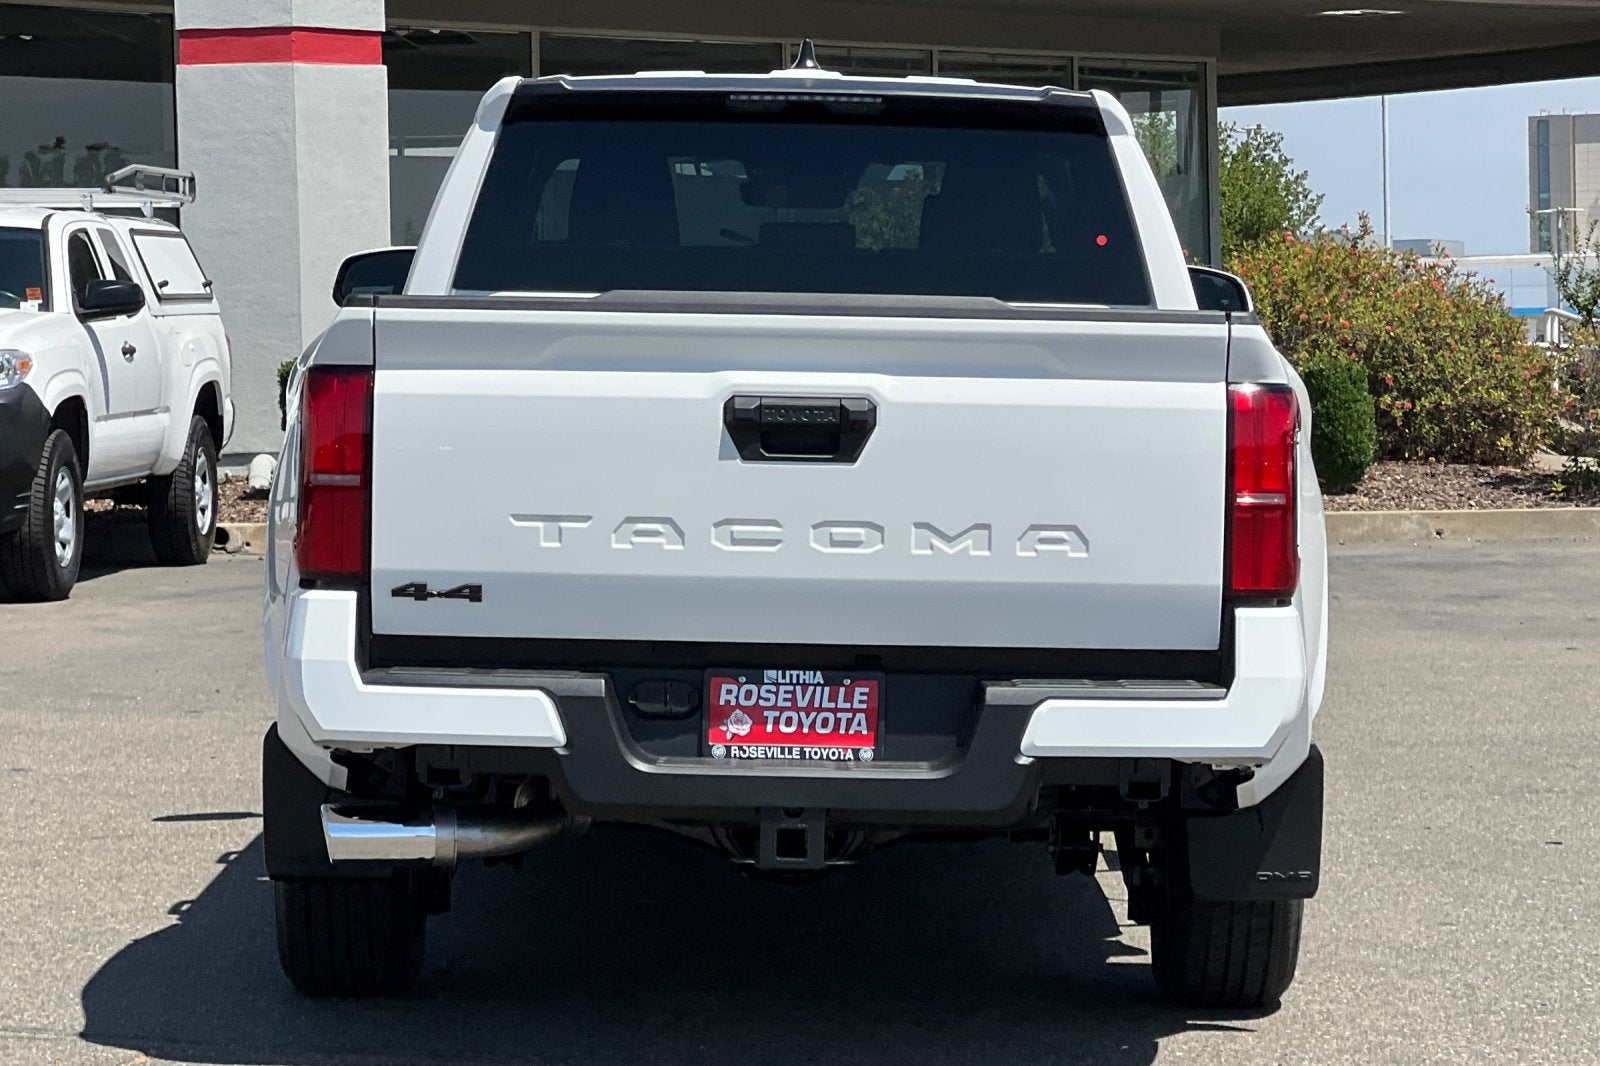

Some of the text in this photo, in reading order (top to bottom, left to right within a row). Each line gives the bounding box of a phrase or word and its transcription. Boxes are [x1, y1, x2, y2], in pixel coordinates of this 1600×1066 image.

[508, 513, 1091, 559] TACOMA
[777, 670, 825, 684] LITHIA
[719, 684, 869, 709] ROSEVILLE
[763, 711, 868, 734] TOYOTA
[731, 745, 855, 760] ROSEVILLE TOYOTA
